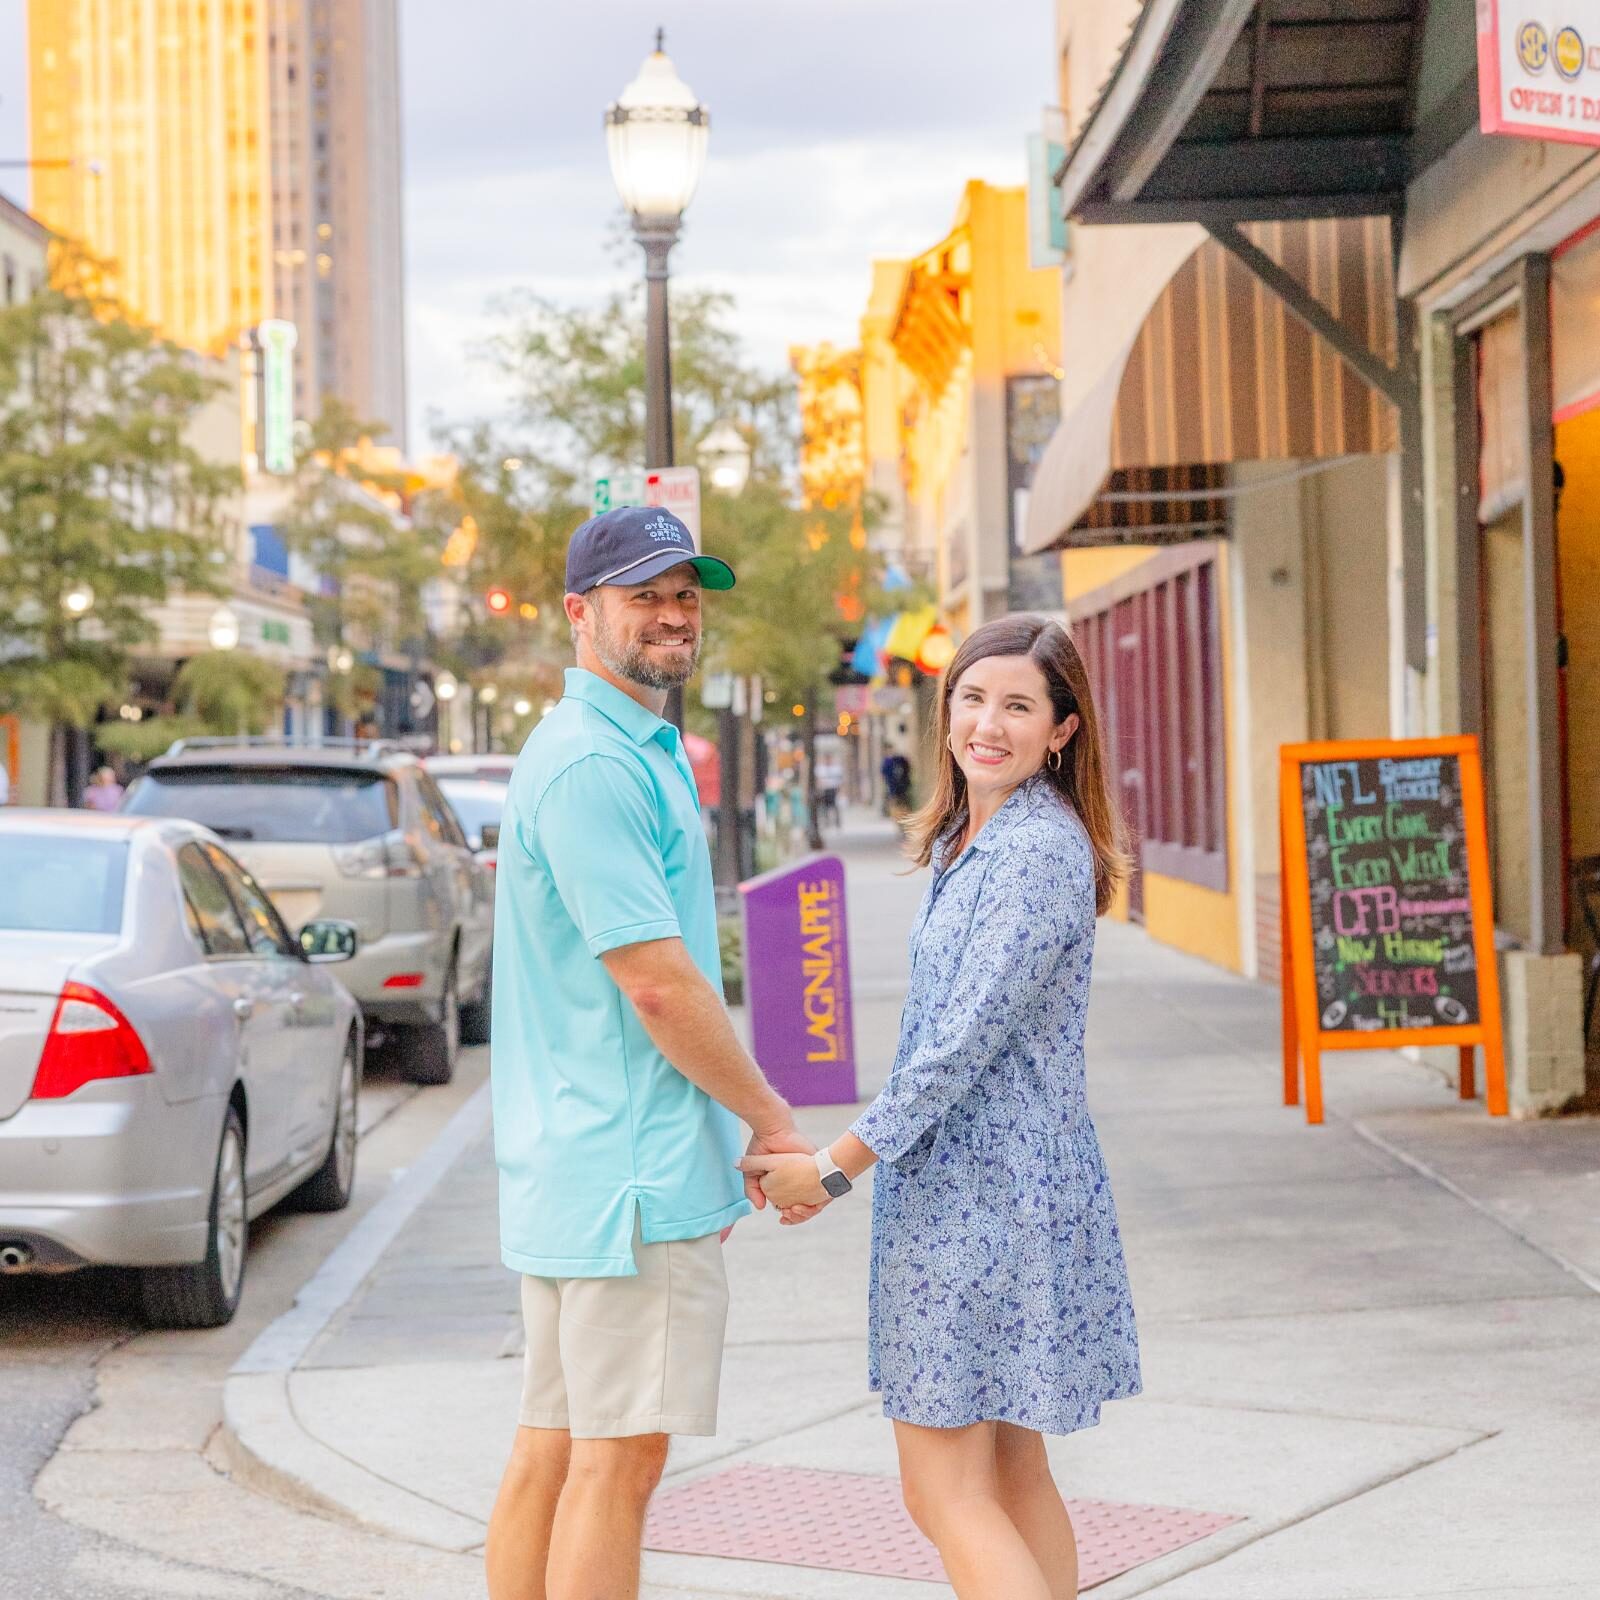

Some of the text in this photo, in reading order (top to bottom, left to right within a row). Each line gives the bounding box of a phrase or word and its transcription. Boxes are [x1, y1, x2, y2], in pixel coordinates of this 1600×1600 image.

[1509, 87, 1563, 116] OPEN
[1313, 761, 1377, 808] NFL
[799, 879, 837, 1063] LAGNIAPPE
